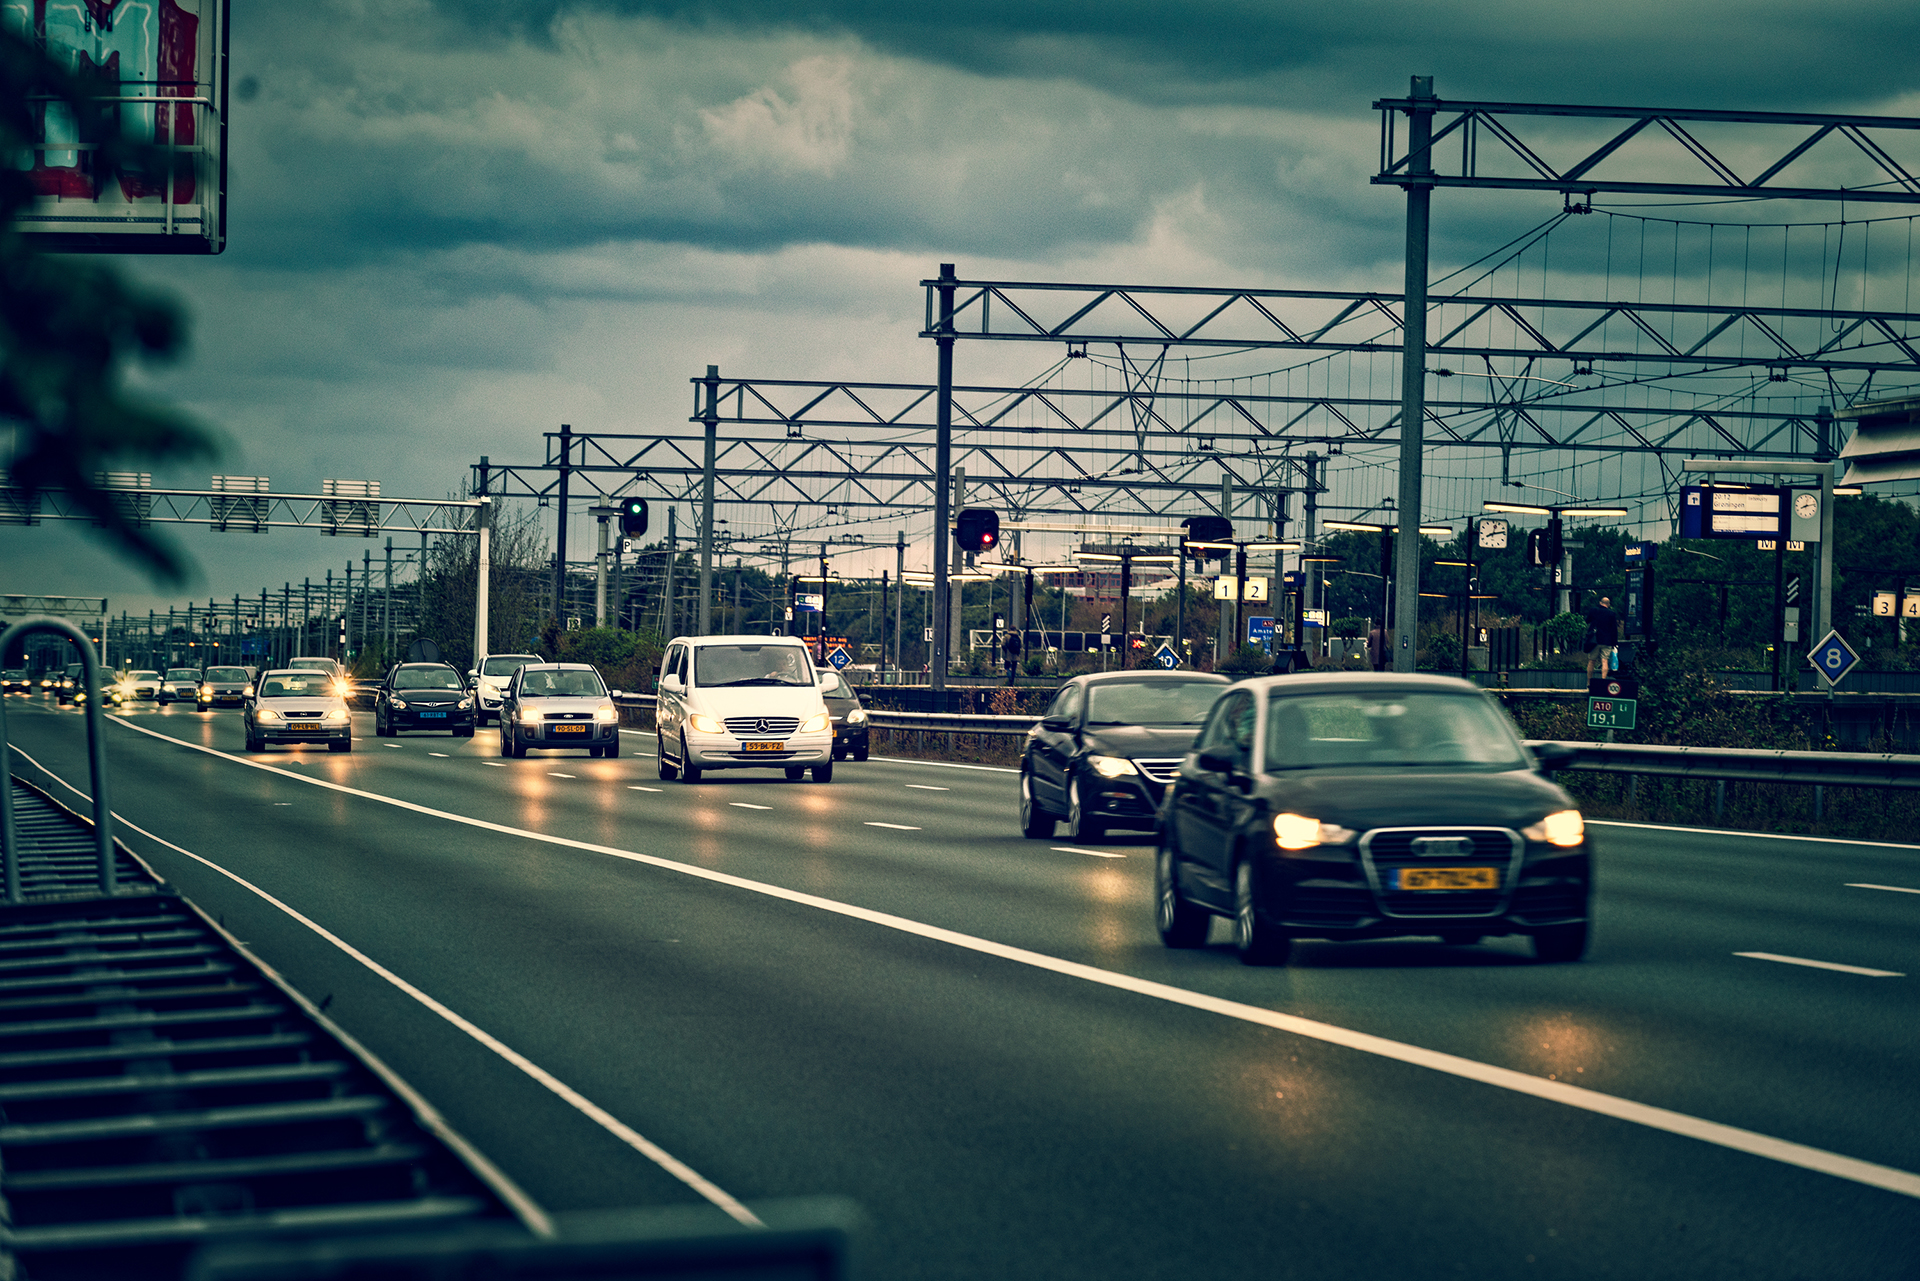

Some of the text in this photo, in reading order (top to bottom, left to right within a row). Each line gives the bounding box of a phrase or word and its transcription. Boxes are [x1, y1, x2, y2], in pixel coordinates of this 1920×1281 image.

[1221, 585, 1228, 597] 1
[1251, 585, 1259, 598] 2
[1880, 601, 1889, 614] 3
[1908, 603, 1918, 615] 4
[834, 655, 845, 665] 12
[1159, 656, 1173, 668] 10
[1826, 648, 1841, 668] 8
[1594, 702, 1611, 711] A10
[1592, 713, 1616, 725] 19.1
